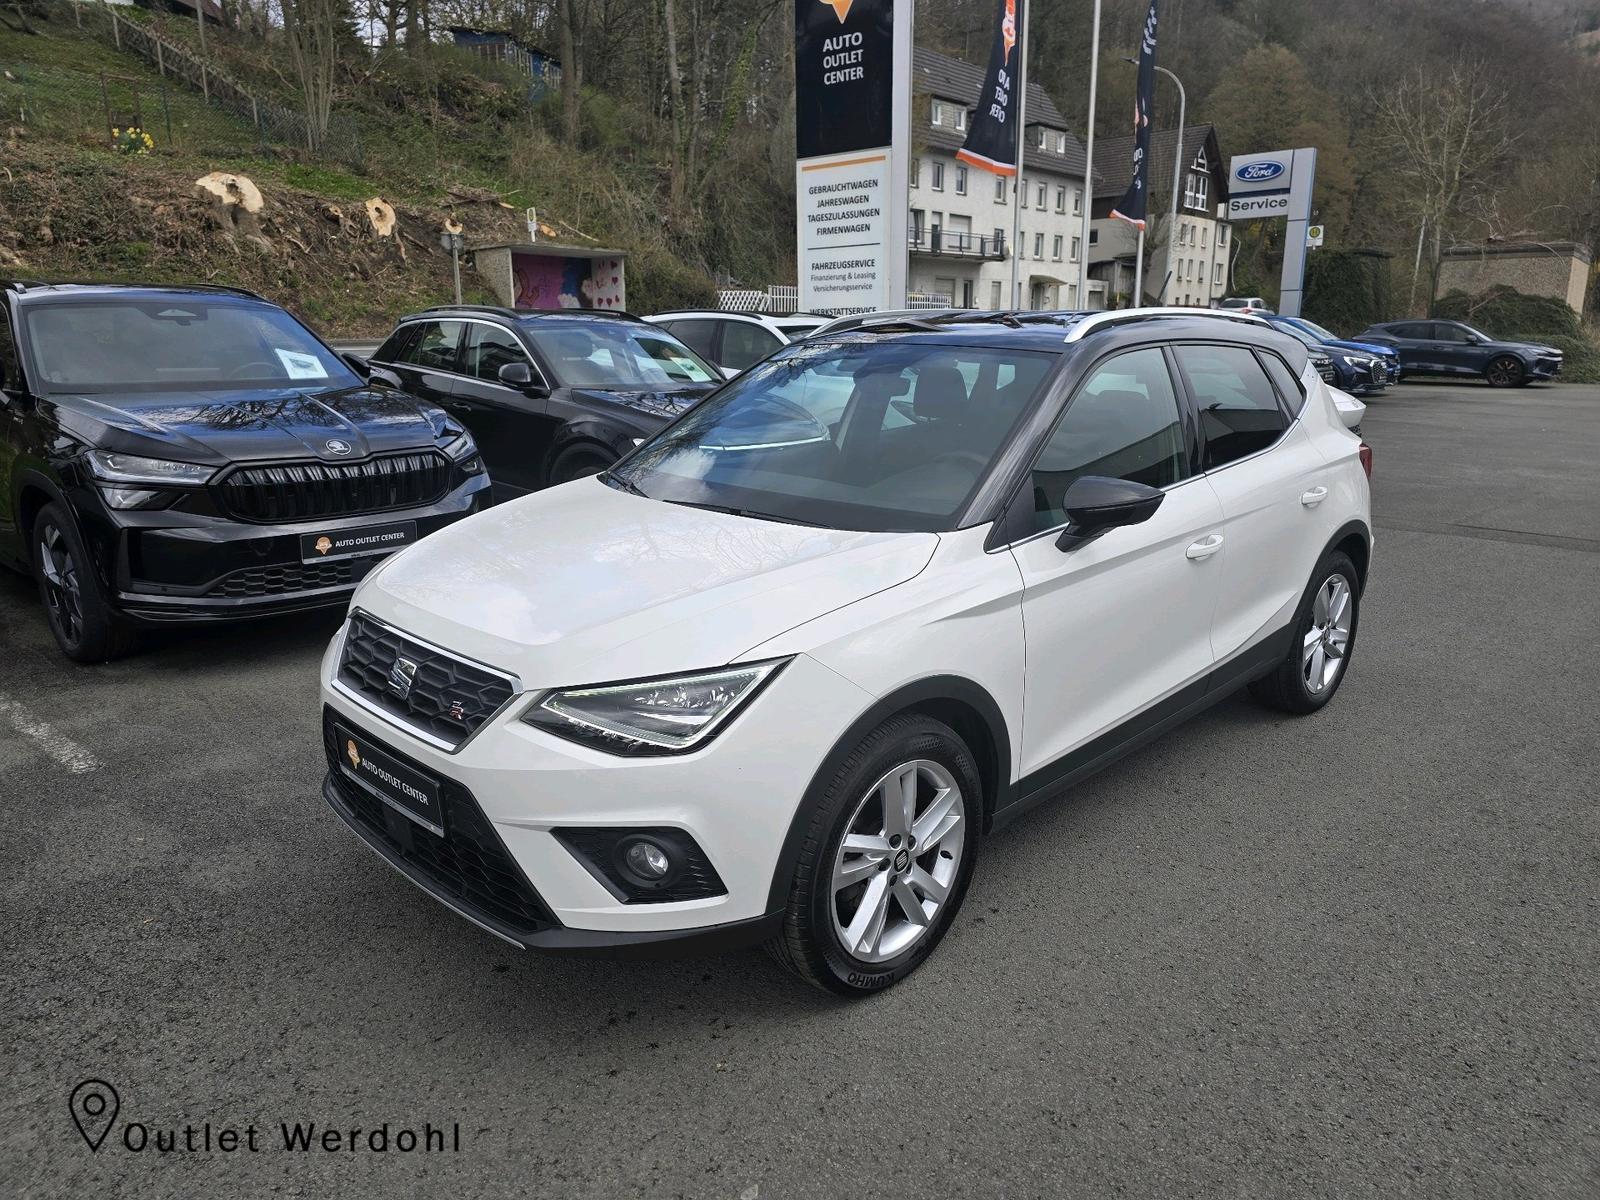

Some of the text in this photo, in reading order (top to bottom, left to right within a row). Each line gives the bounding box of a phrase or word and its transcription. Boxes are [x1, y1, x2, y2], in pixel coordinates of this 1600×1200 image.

[823, 32, 863, 52] AUTO
[823, 49, 864, 69] OUTLET
[823, 66, 864, 85] CENTER
[1244, 164, 1275, 178] Ford
[808, 179, 879, 195] GEBRAUCHTWAGEN
[817, 194, 870, 208] JAHRESWAGEN
[1230, 198, 1288, 212] Service
[808, 208, 880, 222] TAGESZULASSUNGEN
[816, 223, 871, 236] FIRMENWAGEN
[811, 258, 876, 271] FAHRZEUGSERVICE
[810, 271, 876, 282] Finanzierung & Leasing
[812, 282, 873, 293] Versicherungsservice
[335, 532, 405, 548] AUTO OUTLET CENTER
[361, 757, 378, 776] AUTO
[378, 767, 402, 790] OUTLET
[401, 782, 429, 806] CENTER
[847, 971, 896, 988] KUMHO
